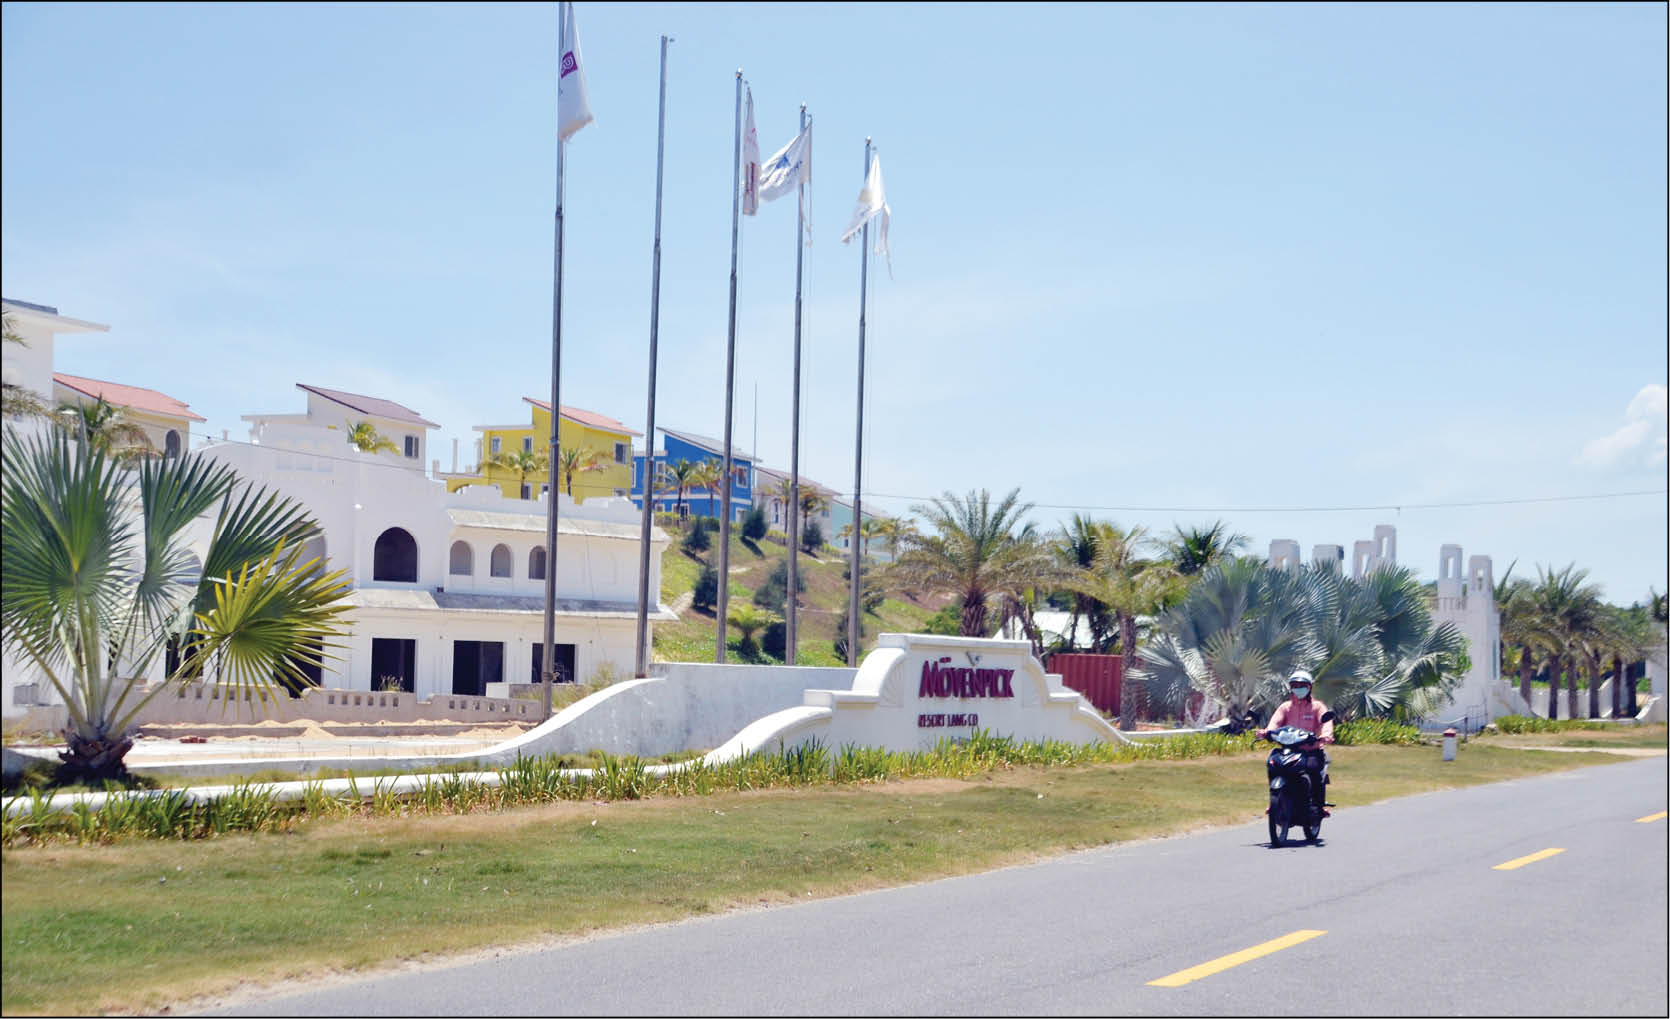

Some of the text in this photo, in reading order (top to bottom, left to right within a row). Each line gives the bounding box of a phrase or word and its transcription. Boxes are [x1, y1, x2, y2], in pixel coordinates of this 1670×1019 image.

[918, 656, 1015, 699] MÖVENPICK
[918, 713, 945, 728] RESORT
[947, 713, 967, 727] LANG
